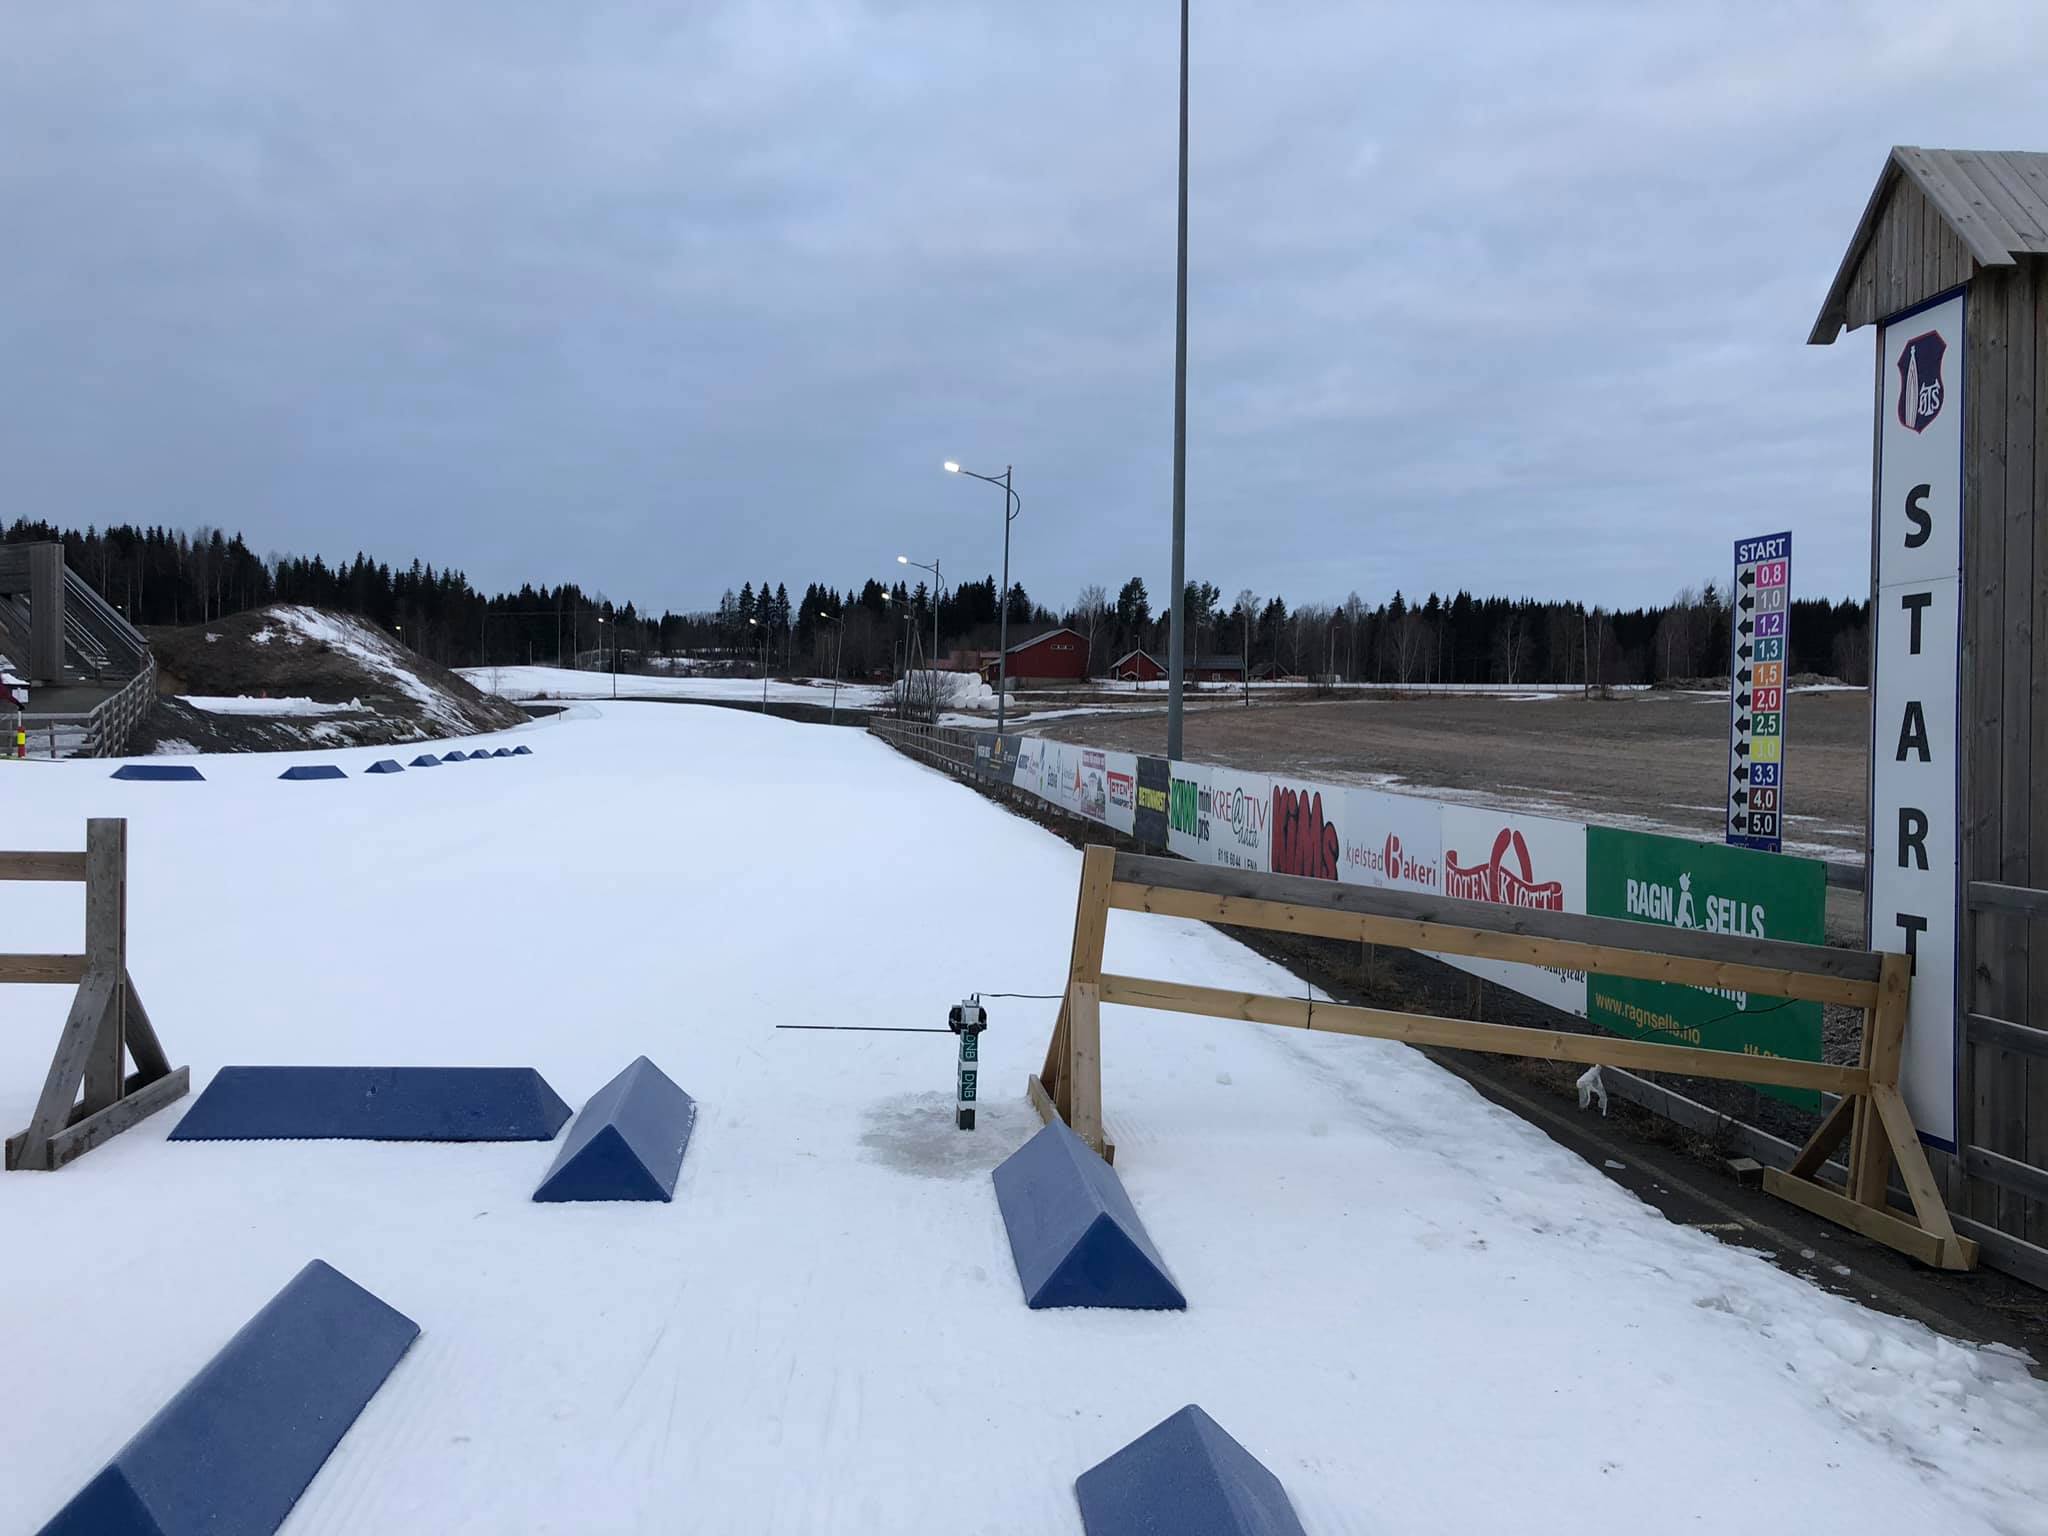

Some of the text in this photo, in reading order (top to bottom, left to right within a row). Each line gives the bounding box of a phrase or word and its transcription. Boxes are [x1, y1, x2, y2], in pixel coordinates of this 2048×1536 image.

[1739, 538, 1785, 562] START
[1761, 565, 1781, 585] 0,8
[1761, 589, 1780, 611] 1,0
[1760, 614, 1779, 635] 1,2
[1759, 640, 1778, 661] 1,3
[1758, 664, 1777, 687] 1,5
[1757, 690, 1776, 710] 2,0
[1756, 715, 1776, 735] 2,5
[1896, 484, 1933, 977] START
[1755, 765, 1774, 785] 3,3
[1754, 790, 1773, 810] 4,0
[1753, 815, 1772, 835] 5,0
[1447, 868, 1490, 903] TOTEN
[1627, 879, 1765, 938] RAGN SELLS
[1595, 992, 1700, 1045] www.ragnsells.no
[965, 1034, 977, 1059] DNB
[963, 1073, 976, 1098] DNB
